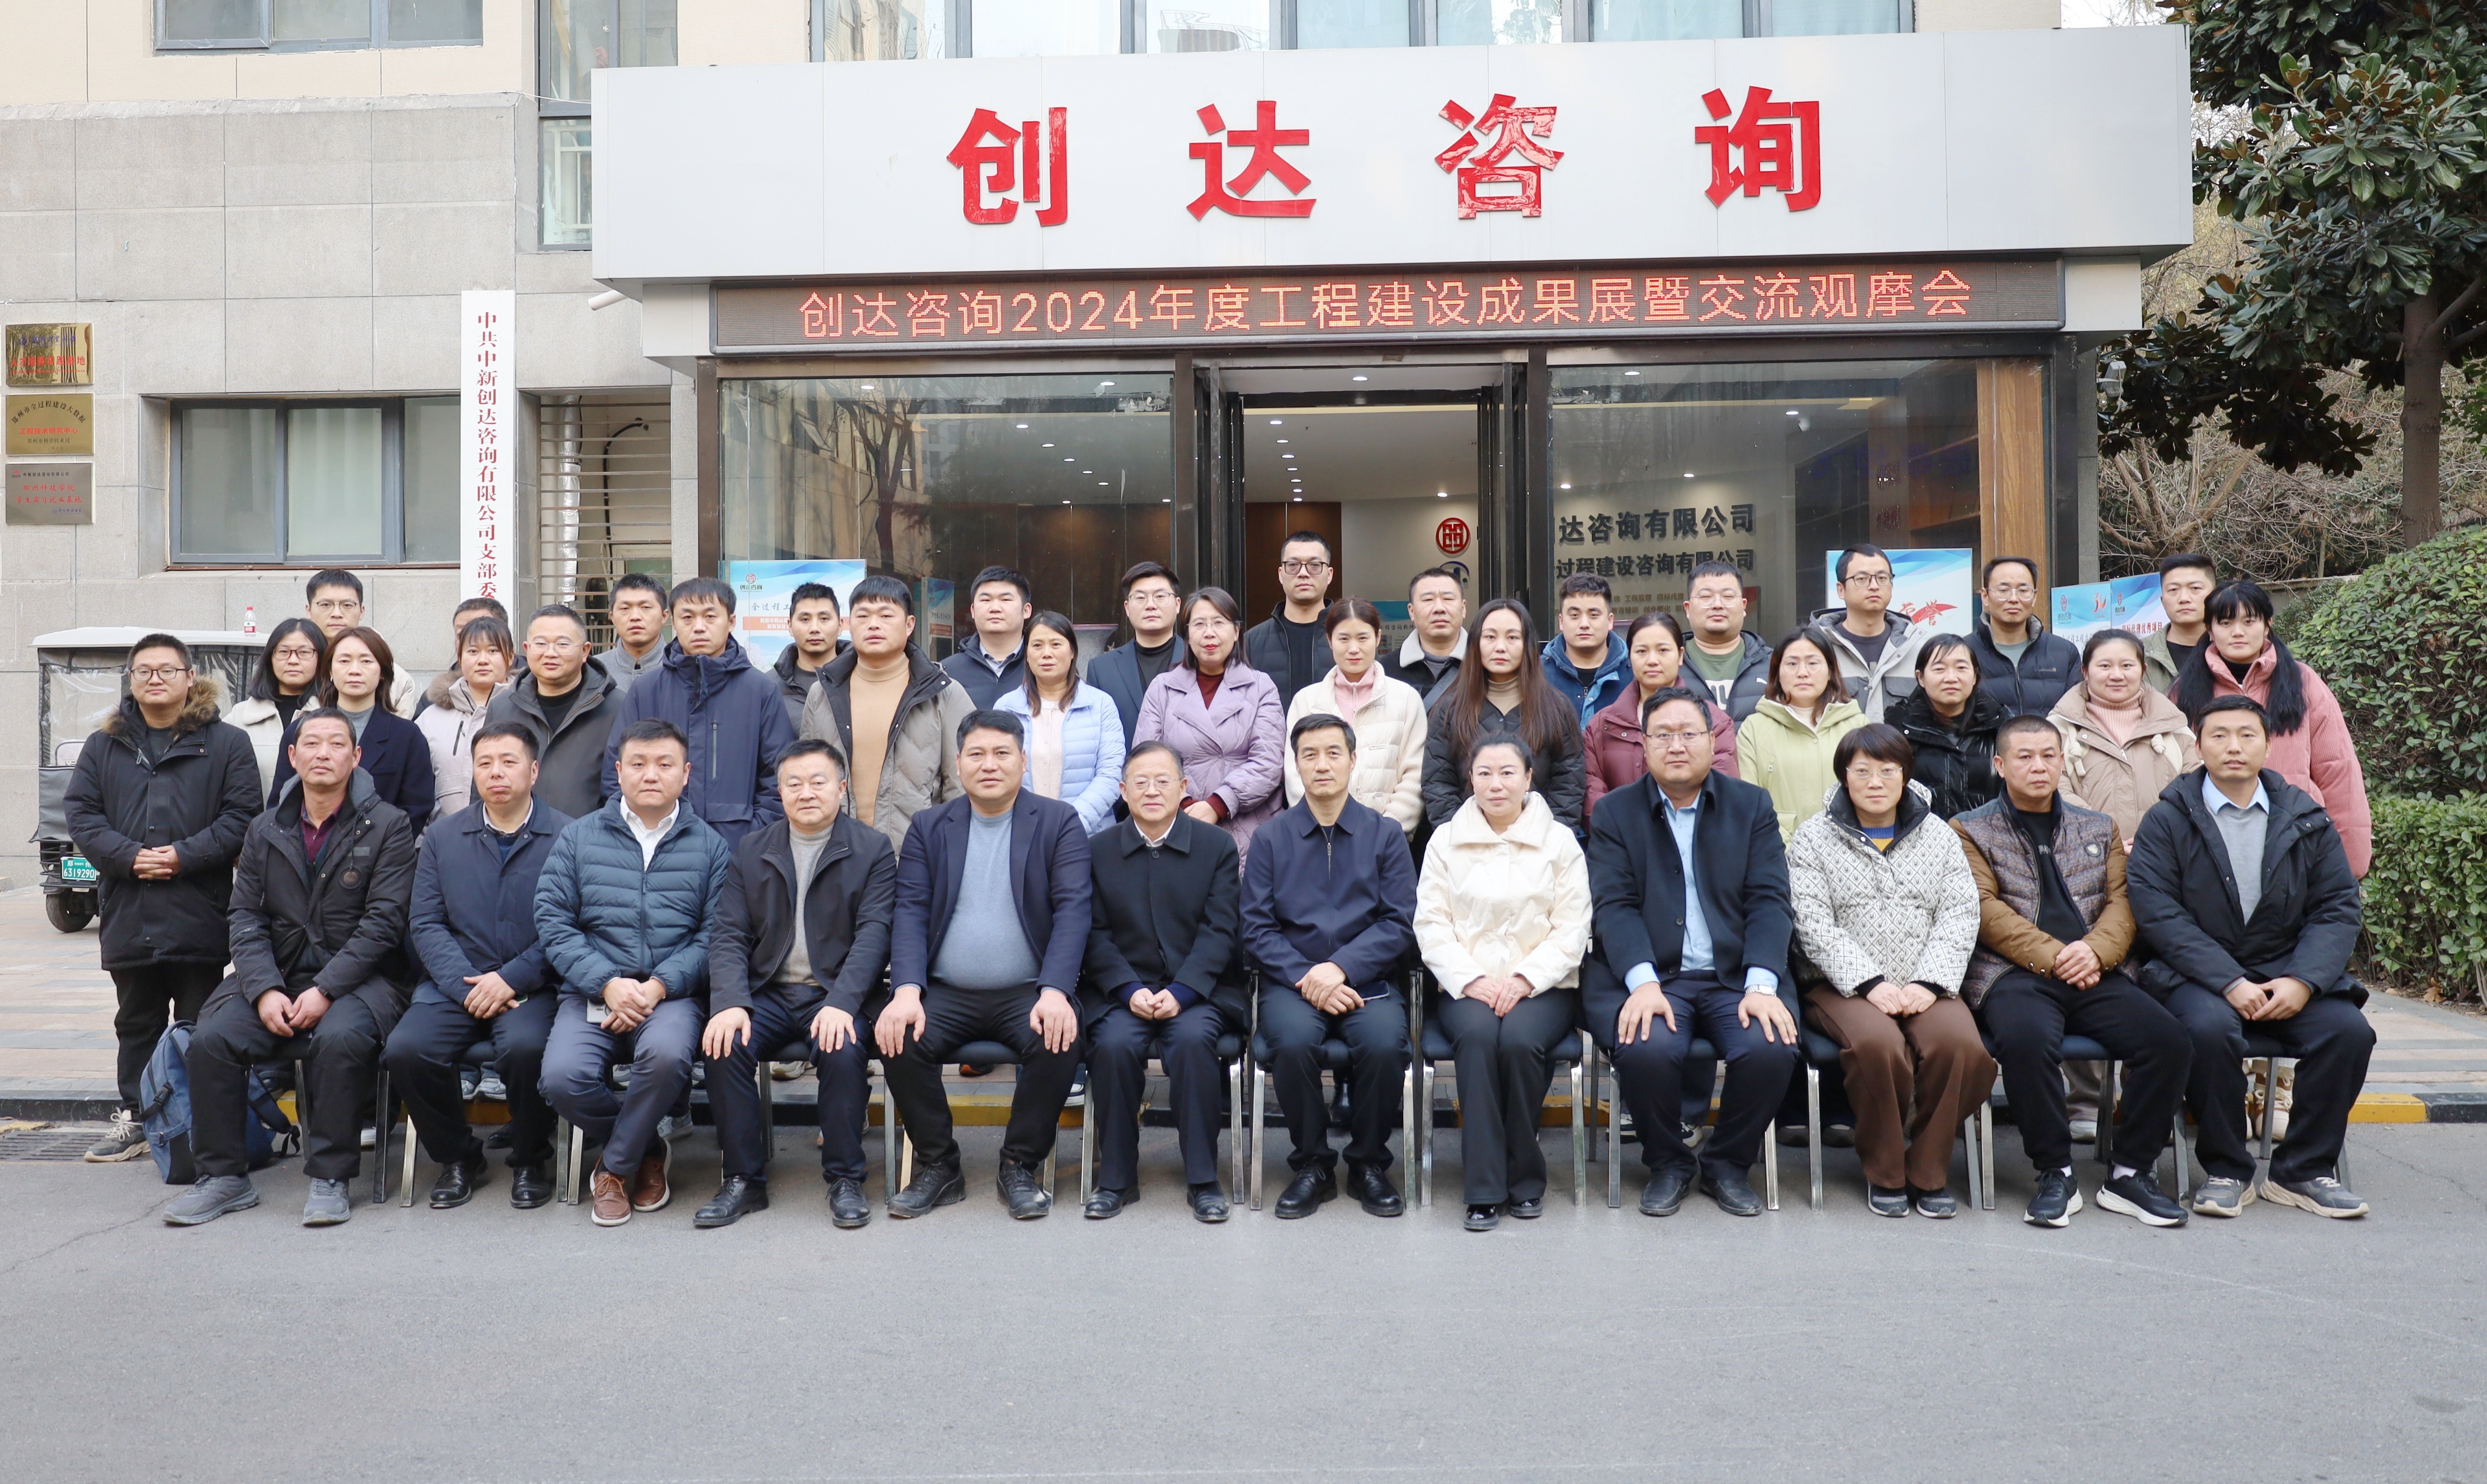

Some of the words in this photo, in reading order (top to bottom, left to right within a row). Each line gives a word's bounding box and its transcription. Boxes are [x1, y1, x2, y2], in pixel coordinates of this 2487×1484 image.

[946, 85, 1822, 226] 创达咨询
[799, 270, 1971, 338] 创达咨询2024年度工程建设成果展暨交流观摩会
[19, 427, 78, 435] 工程技术研究中心
[16, 495, 82, 504] 学生实习就业基地
[1554, 504, 1754, 543] 达咨询有限公司
[64, 868, 95, 878] 6319290
